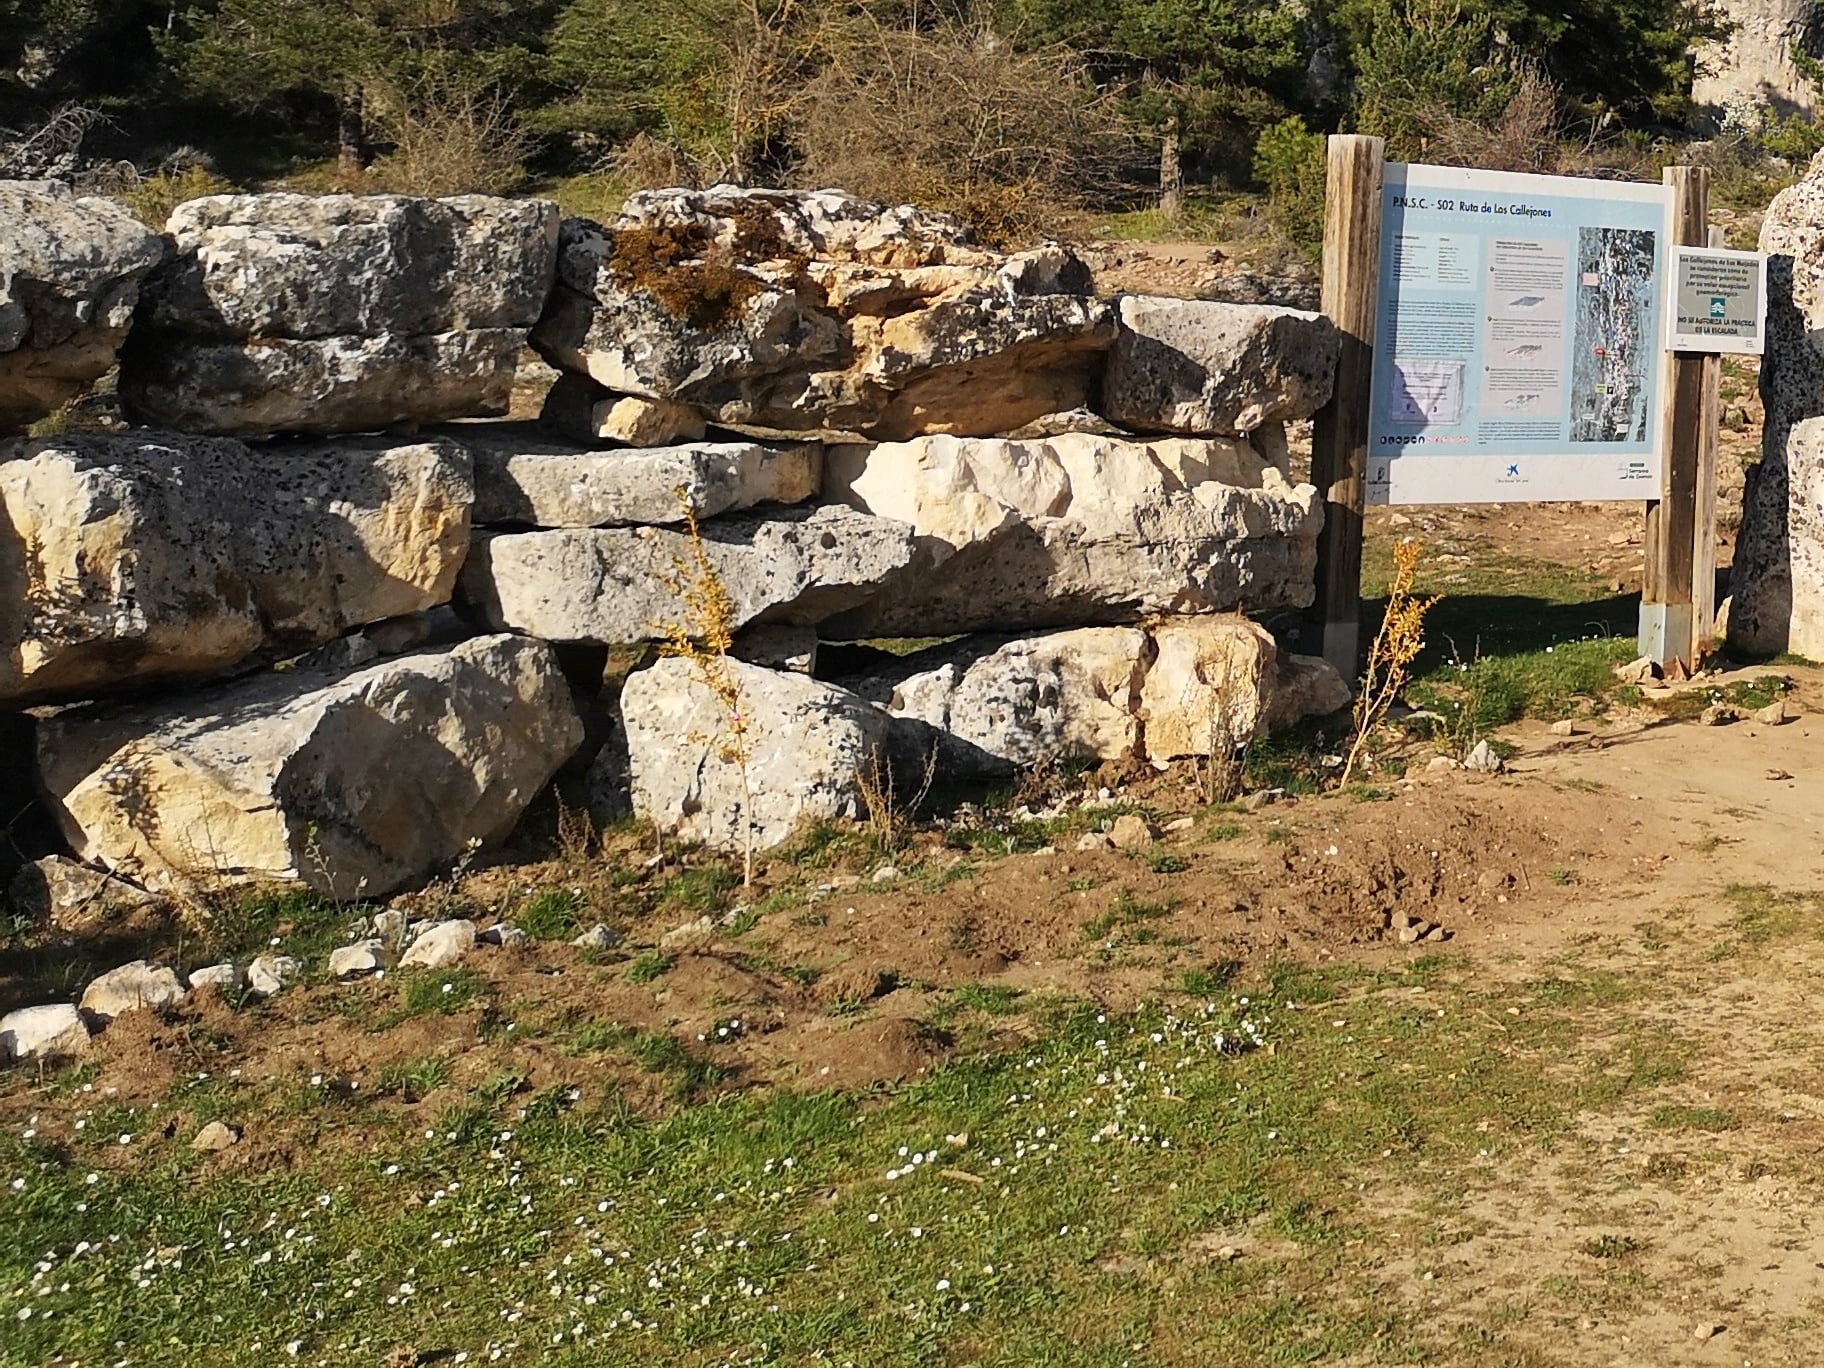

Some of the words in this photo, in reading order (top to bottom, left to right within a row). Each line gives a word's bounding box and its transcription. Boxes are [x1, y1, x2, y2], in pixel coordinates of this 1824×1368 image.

[1392, 196, 1428, 209] P.N.S.C.
[1459, 201, 1478, 212] Ruta
[1481, 202, 1491, 213] de
[1494, 203, 1508, 215] Los
[1509, 204, 1552, 219] Callejones
[1695, 318, 1722, 326] AUTORIZA
